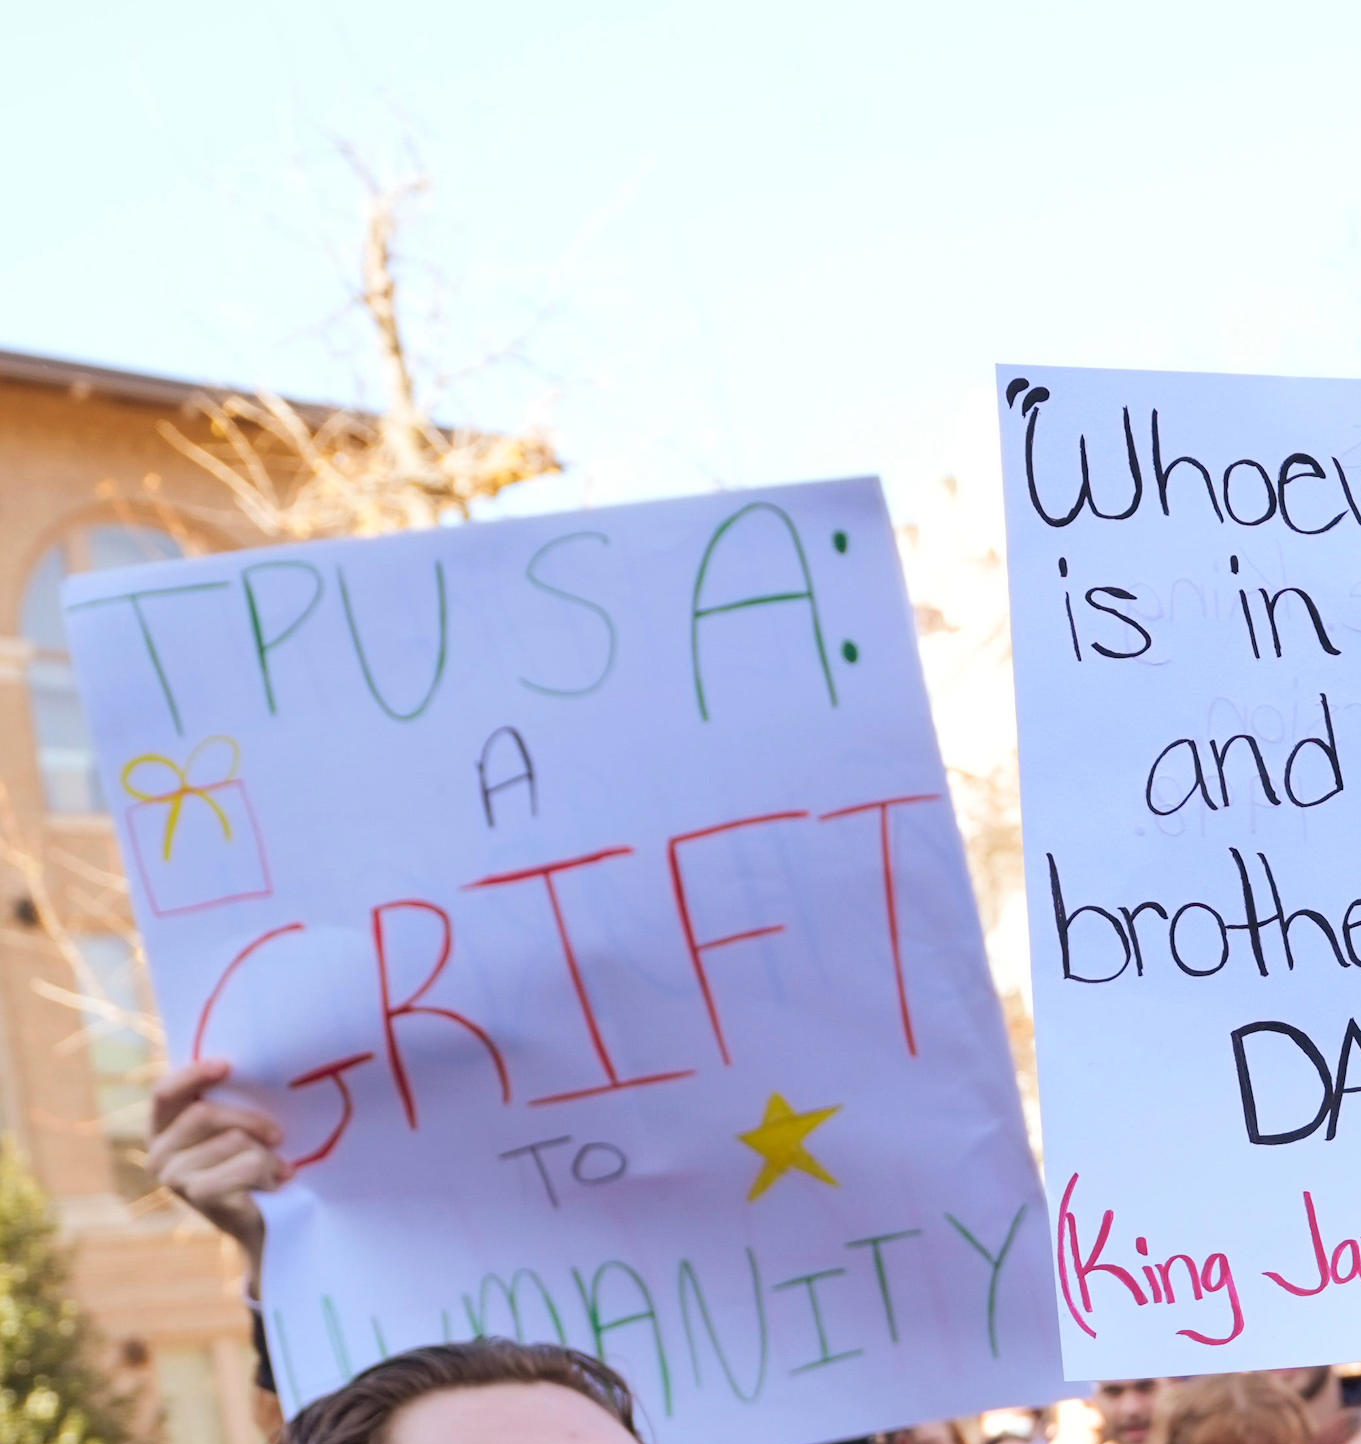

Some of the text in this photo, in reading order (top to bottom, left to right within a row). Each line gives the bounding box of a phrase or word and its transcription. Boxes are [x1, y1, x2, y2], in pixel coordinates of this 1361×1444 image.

[1057, 556, 1152, 662] is
[1231, 554, 1342, 659] in
[477, 725, 537, 828] A
[1146, 692, 1344, 817] and
[192, 794, 944, 1171] GRIFT
[498, 1135, 629, 1210] TO
[1054, 1171, 1245, 1344] (King
